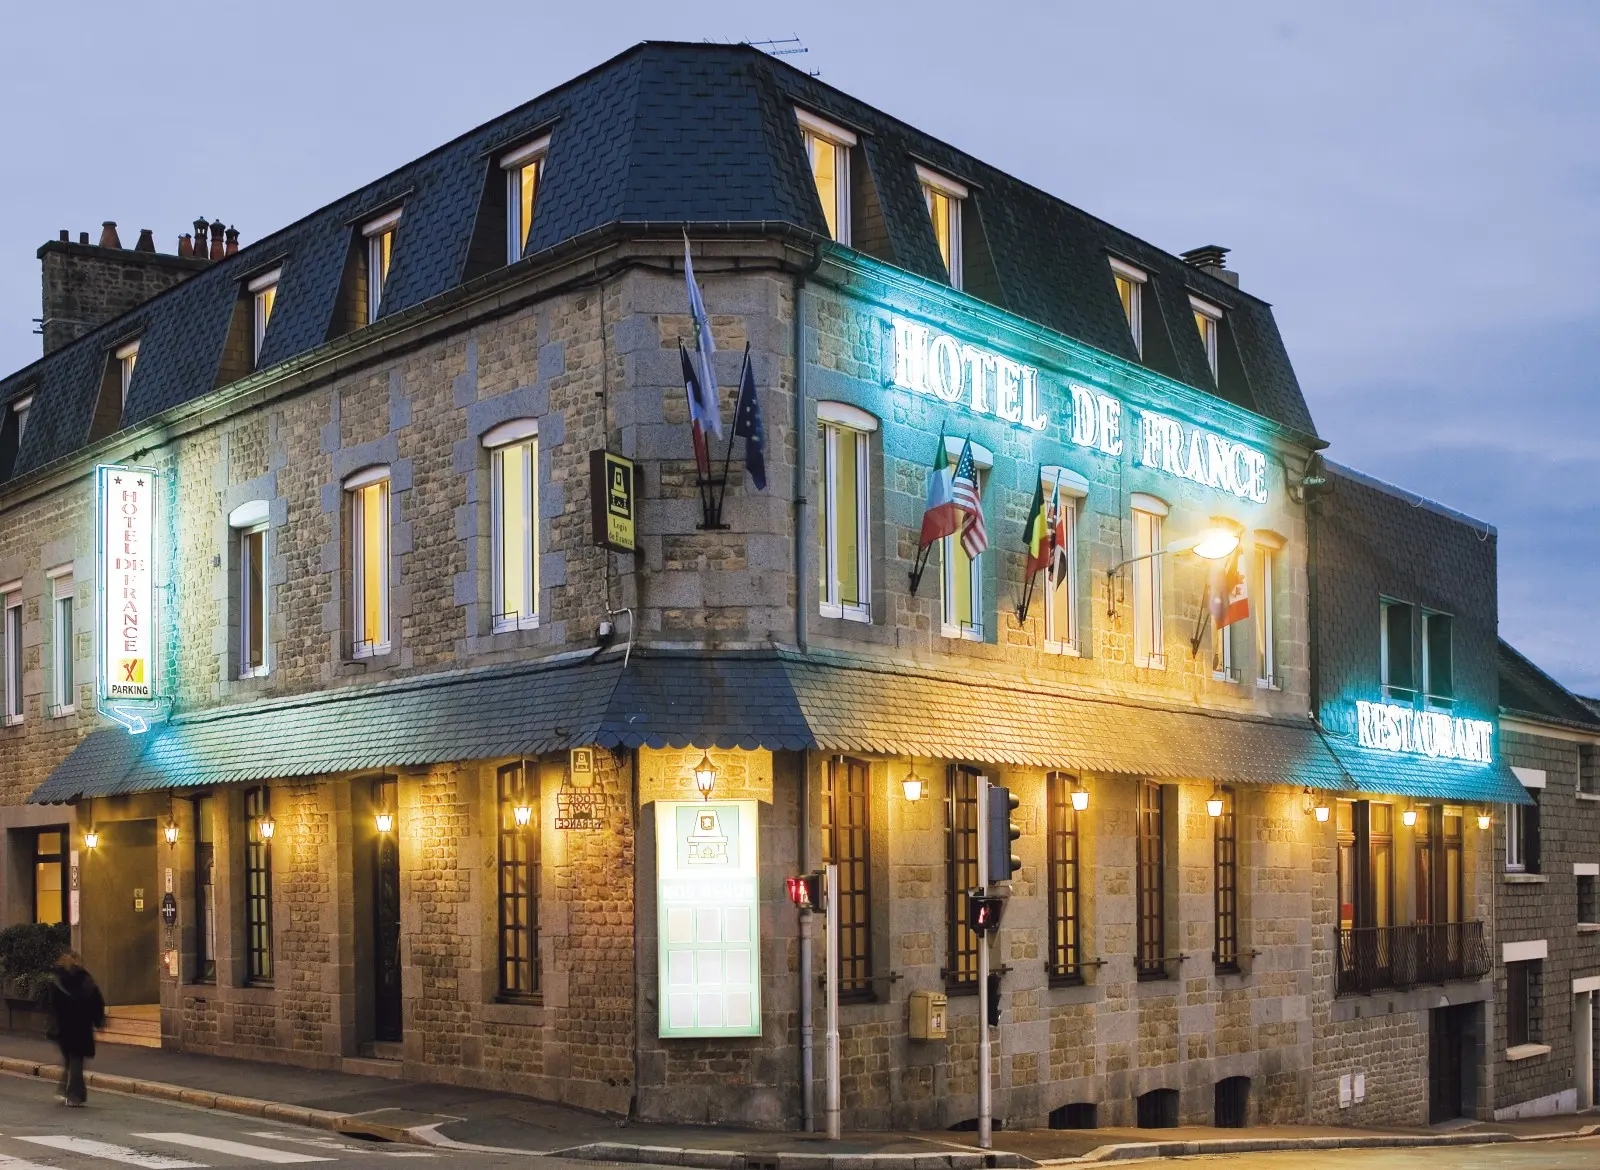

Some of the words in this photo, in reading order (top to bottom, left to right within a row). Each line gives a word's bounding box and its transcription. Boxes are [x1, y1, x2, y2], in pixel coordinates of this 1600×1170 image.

[892, 317, 1048, 431] HOTEL
[1069, 384, 1124, 456] DE
[1139, 409, 1268, 503] FRANCE
[122, 490, 138, 555] HOTEL
[613, 518, 627, 532] Logis
[615, 531, 632, 545] France
[115, 558, 145, 571] DE
[122, 574, 138, 652] FRANCE
[112, 684, 148, 696] PARKING
[1355, 700, 1493, 763] RESTAURANT
